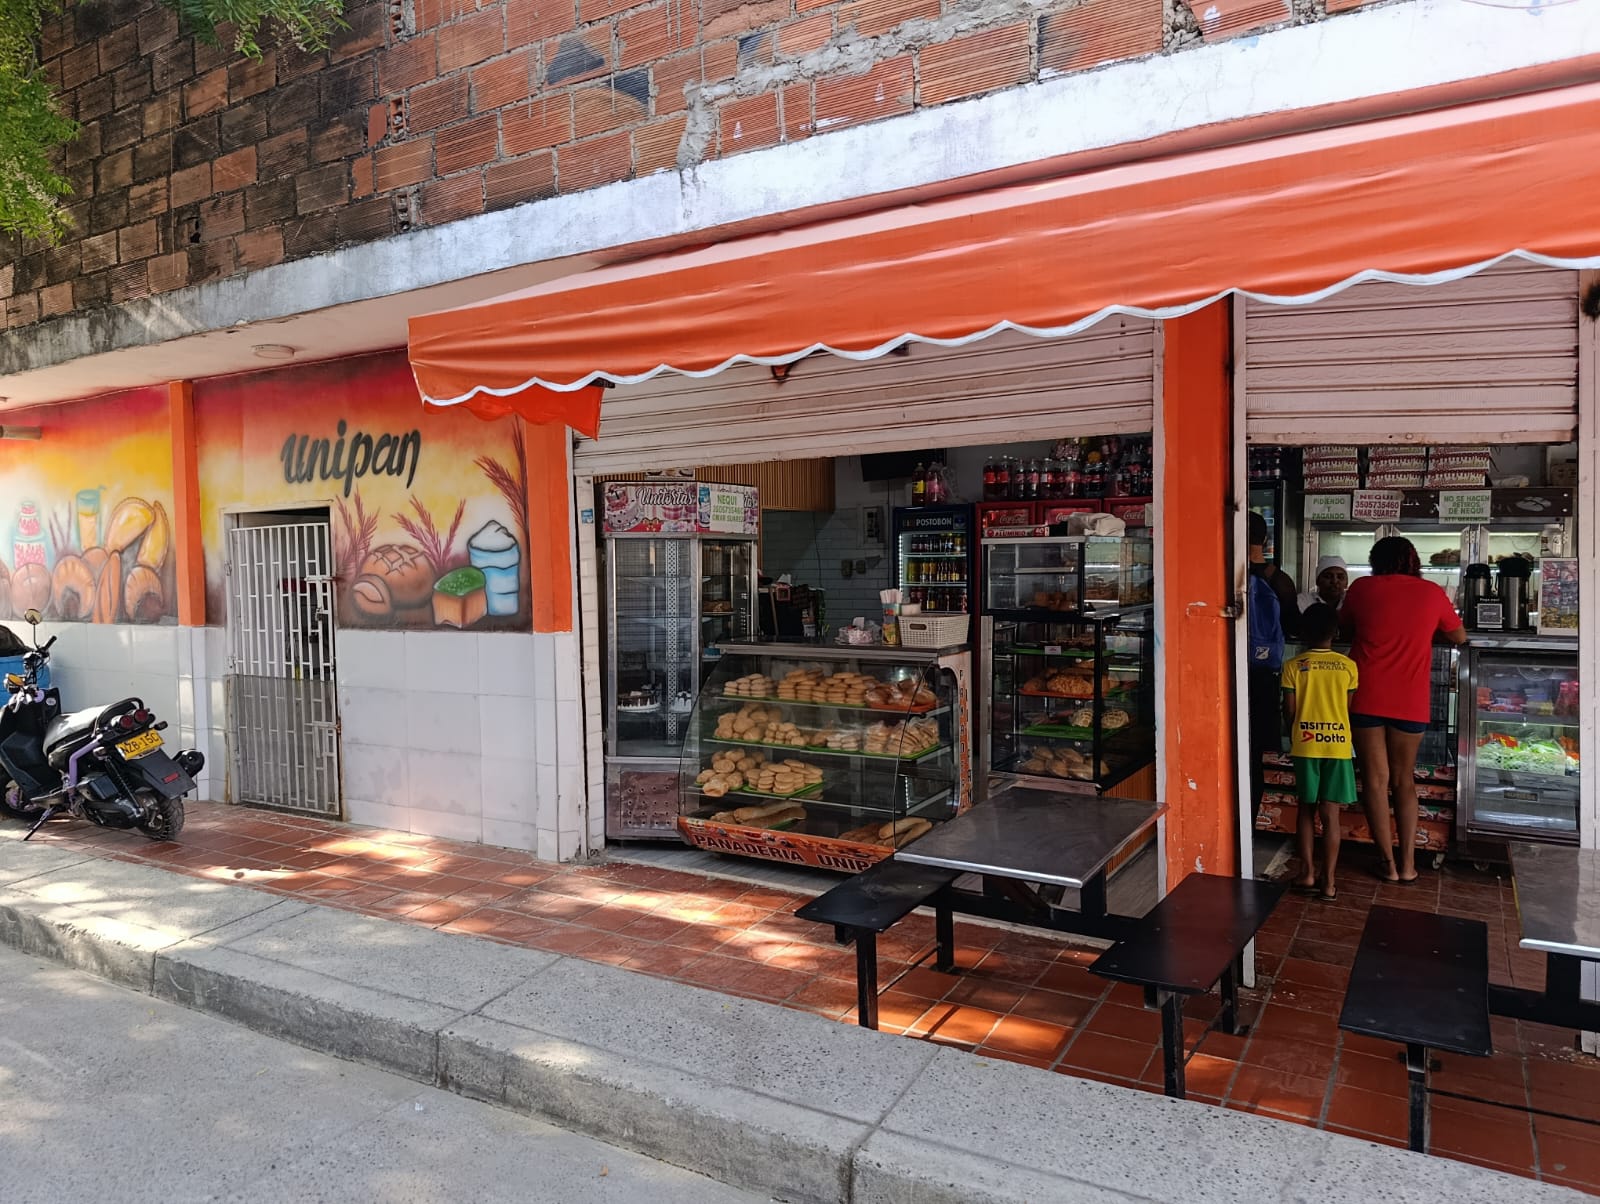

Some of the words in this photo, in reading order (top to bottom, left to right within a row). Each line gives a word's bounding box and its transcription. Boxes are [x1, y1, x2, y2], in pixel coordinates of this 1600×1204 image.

[280, 418, 421, 498] unipan
[717, 494, 737, 506] NEQUI
[1312, 512, 1345, 520] PAGANDO
[1354, 509, 1372, 517] OMAR
[1308, 721, 1345, 731] SITTCA
[1315, 733, 1346, 743] Dotta
[694, 834, 805, 863] PANADERIA
